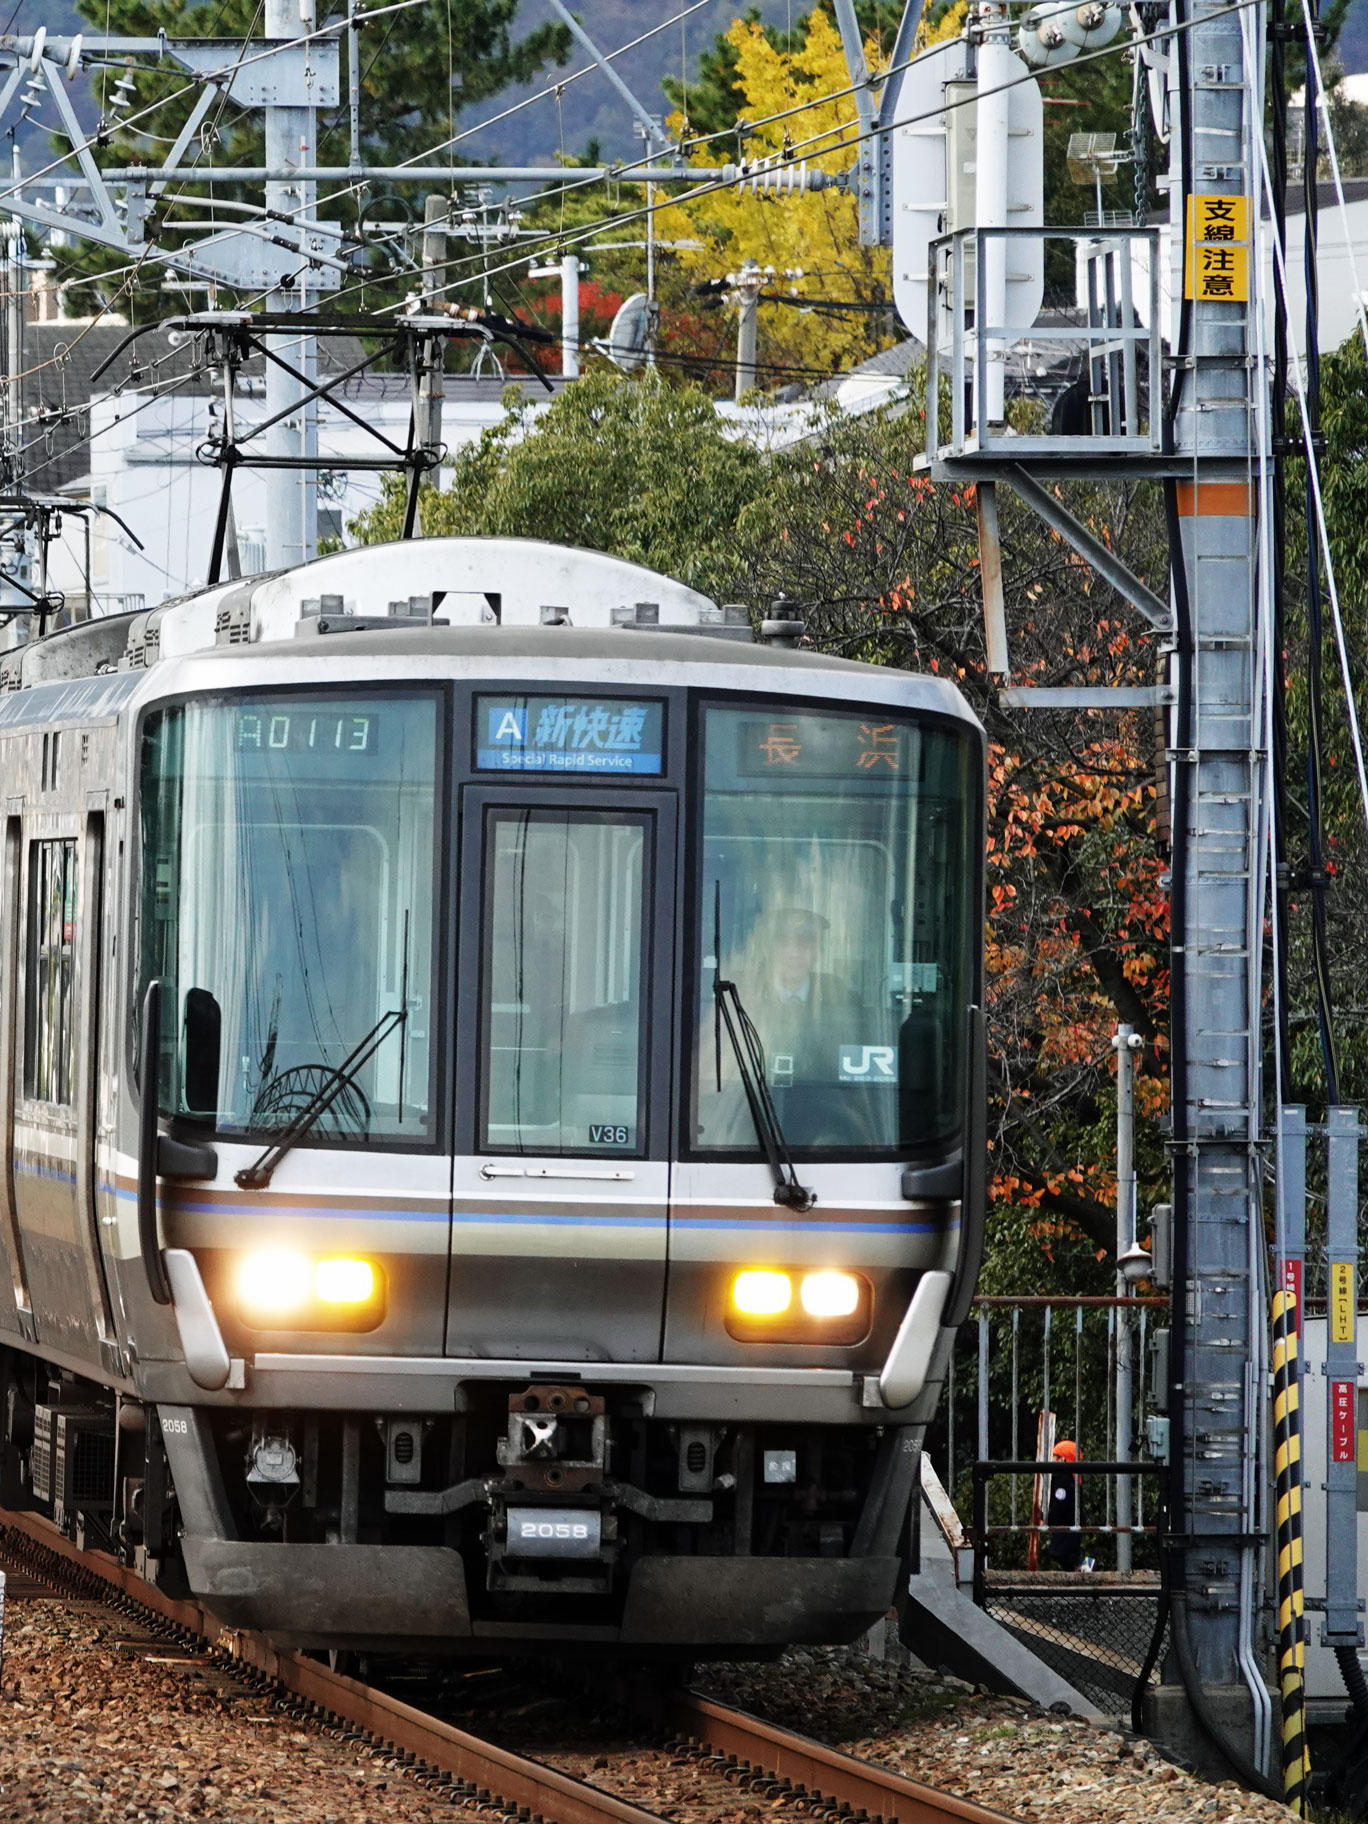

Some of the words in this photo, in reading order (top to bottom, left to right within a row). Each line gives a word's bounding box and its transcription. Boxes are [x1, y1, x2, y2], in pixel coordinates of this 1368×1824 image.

[1202, 199, 1237, 296] 支線注意
[238, 715, 370, 750] A0113
[495, 712, 522, 740] A
[534, 704, 649, 750] 新快速
[502, 752, 546, 768] Special
[549, 754, 585, 768] Rapid
[587, 755, 633, 768] Service
[759, 724, 900, 769] 長浜
[842, 1045, 894, 1075] JR
[591, 1126, 627, 1143] V36
[162, 1419, 188, 1434] 2058
[1338, 1384, 1348, 1460] 高圧ケーブル
[521, 1522, 588, 1539] 2058
